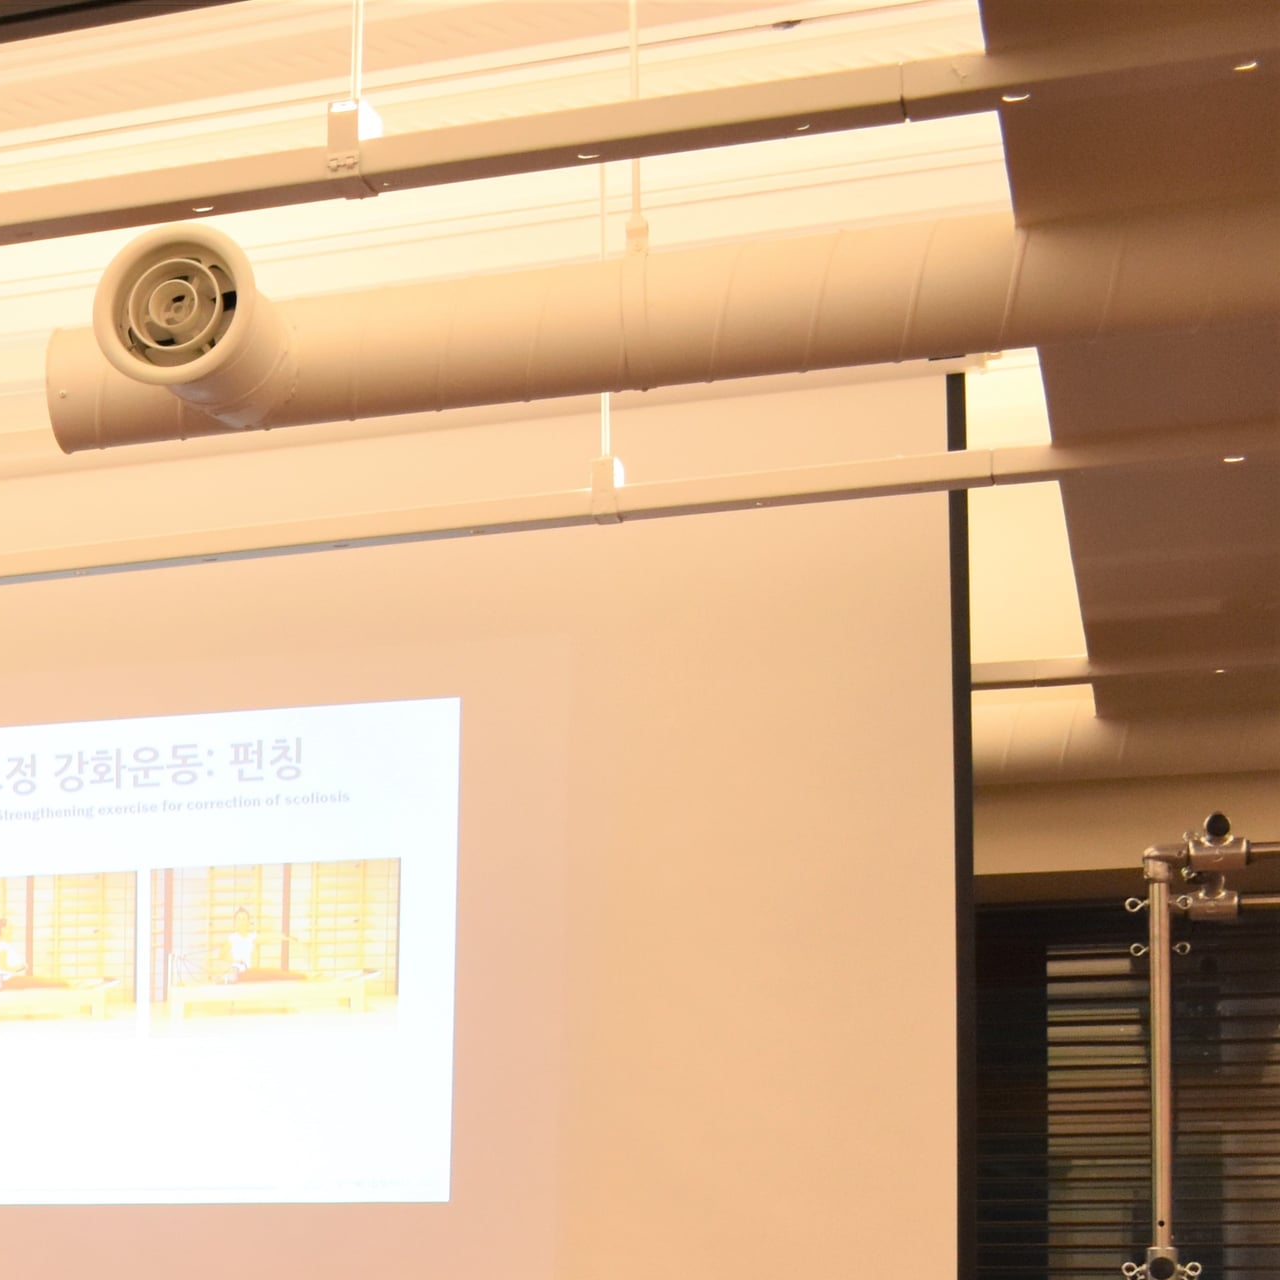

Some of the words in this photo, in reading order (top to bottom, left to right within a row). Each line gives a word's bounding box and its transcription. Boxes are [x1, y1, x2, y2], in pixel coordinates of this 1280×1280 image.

[54, 743, 214, 793] 강화운동:
[229, 737, 302, 782] 펀칭
[98, 801, 158, 816] exercise
[162, 799, 183, 812] for
[187, 795, 261, 811] correction
[265, 794, 281, 806] of
[285, 790, 351, 806] scoliosis
